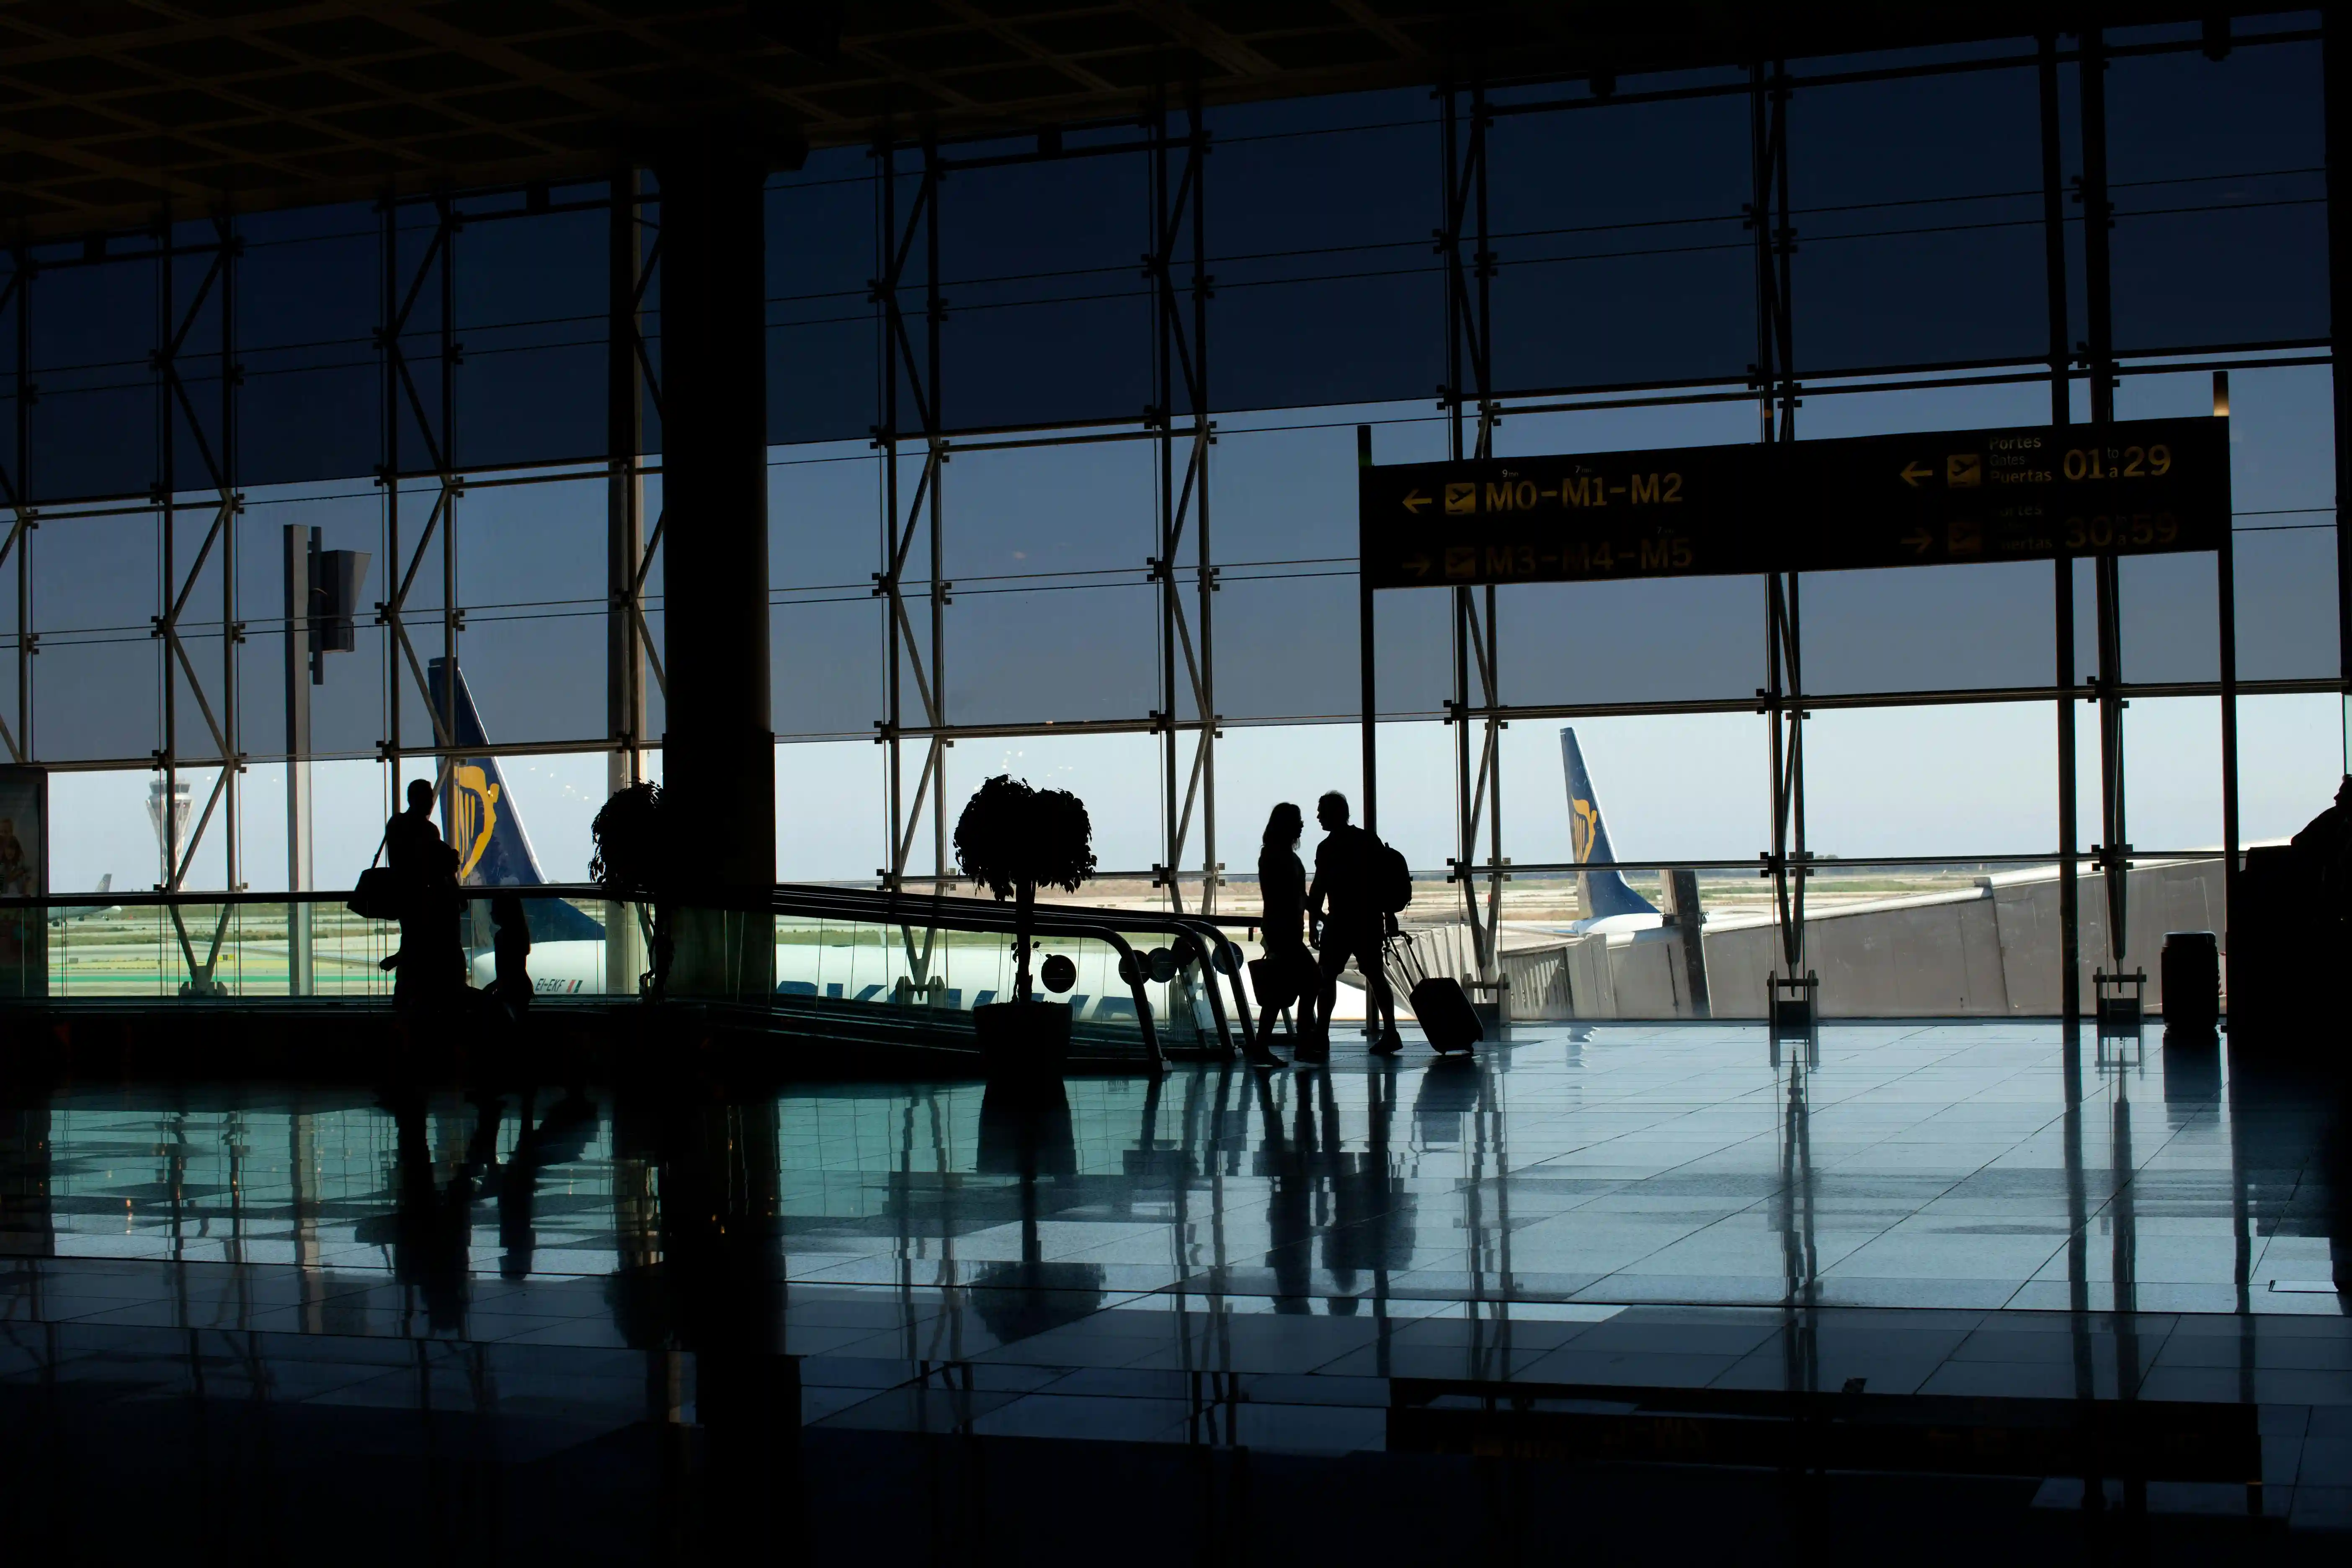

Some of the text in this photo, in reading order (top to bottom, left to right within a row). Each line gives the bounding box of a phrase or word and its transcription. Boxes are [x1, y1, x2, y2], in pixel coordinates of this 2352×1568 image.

[1989, 437, 2042, 450] Portes
[1989, 454, 2025, 466] Gates
[2063, 444, 2171, 480] 01 to a 29
[1990, 470, 2052, 484] Puertas
[1485, 472, 1684, 513] M0-M1-M2
[2064, 514, 2112, 548] 30
[2132, 510, 2177, 545] 59
[1485, 537, 1692, 576] M3-M4-M5
[536, 978, 565, 992] EI-EKF
